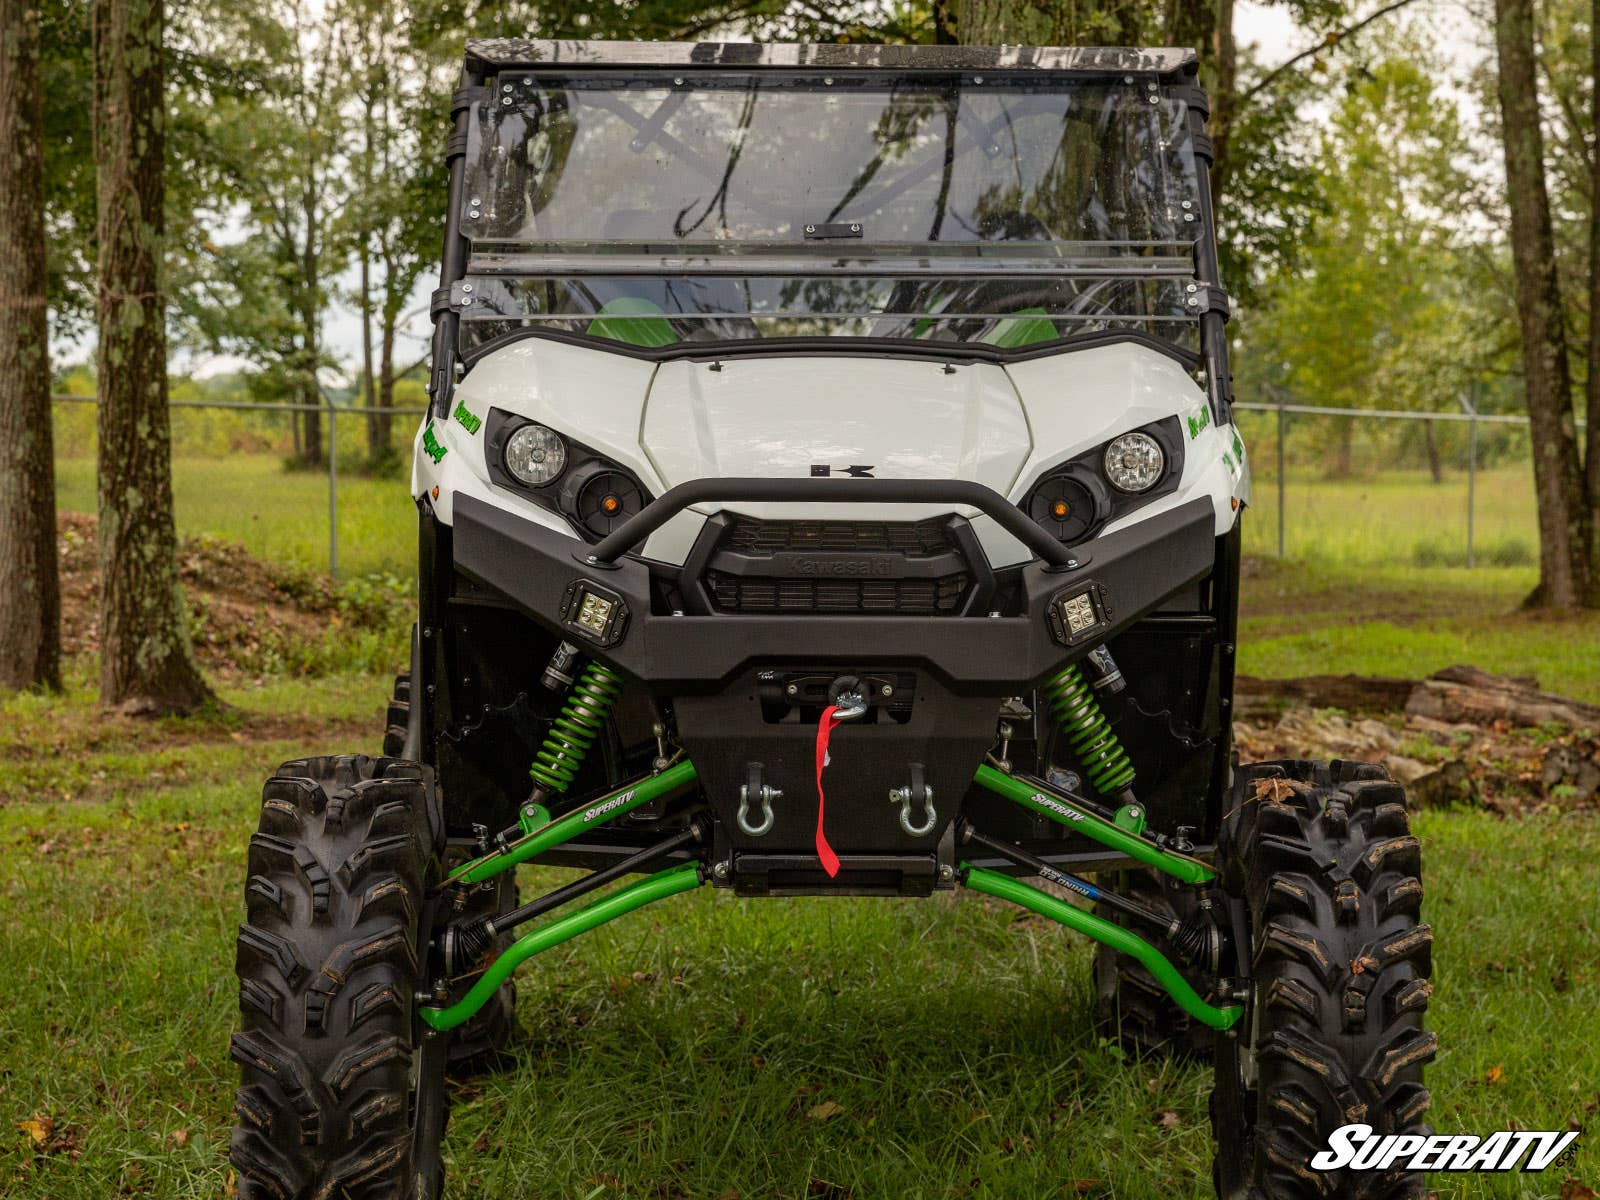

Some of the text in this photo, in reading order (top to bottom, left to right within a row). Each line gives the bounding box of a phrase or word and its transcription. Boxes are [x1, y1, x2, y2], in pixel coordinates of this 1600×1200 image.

[783, 557, 893, 575] Kawasaki
[583, 790, 636, 822] SUPERATV
[1031, 793, 1085, 822] SUPERATV
[1057, 878, 1090, 896] RHINO
